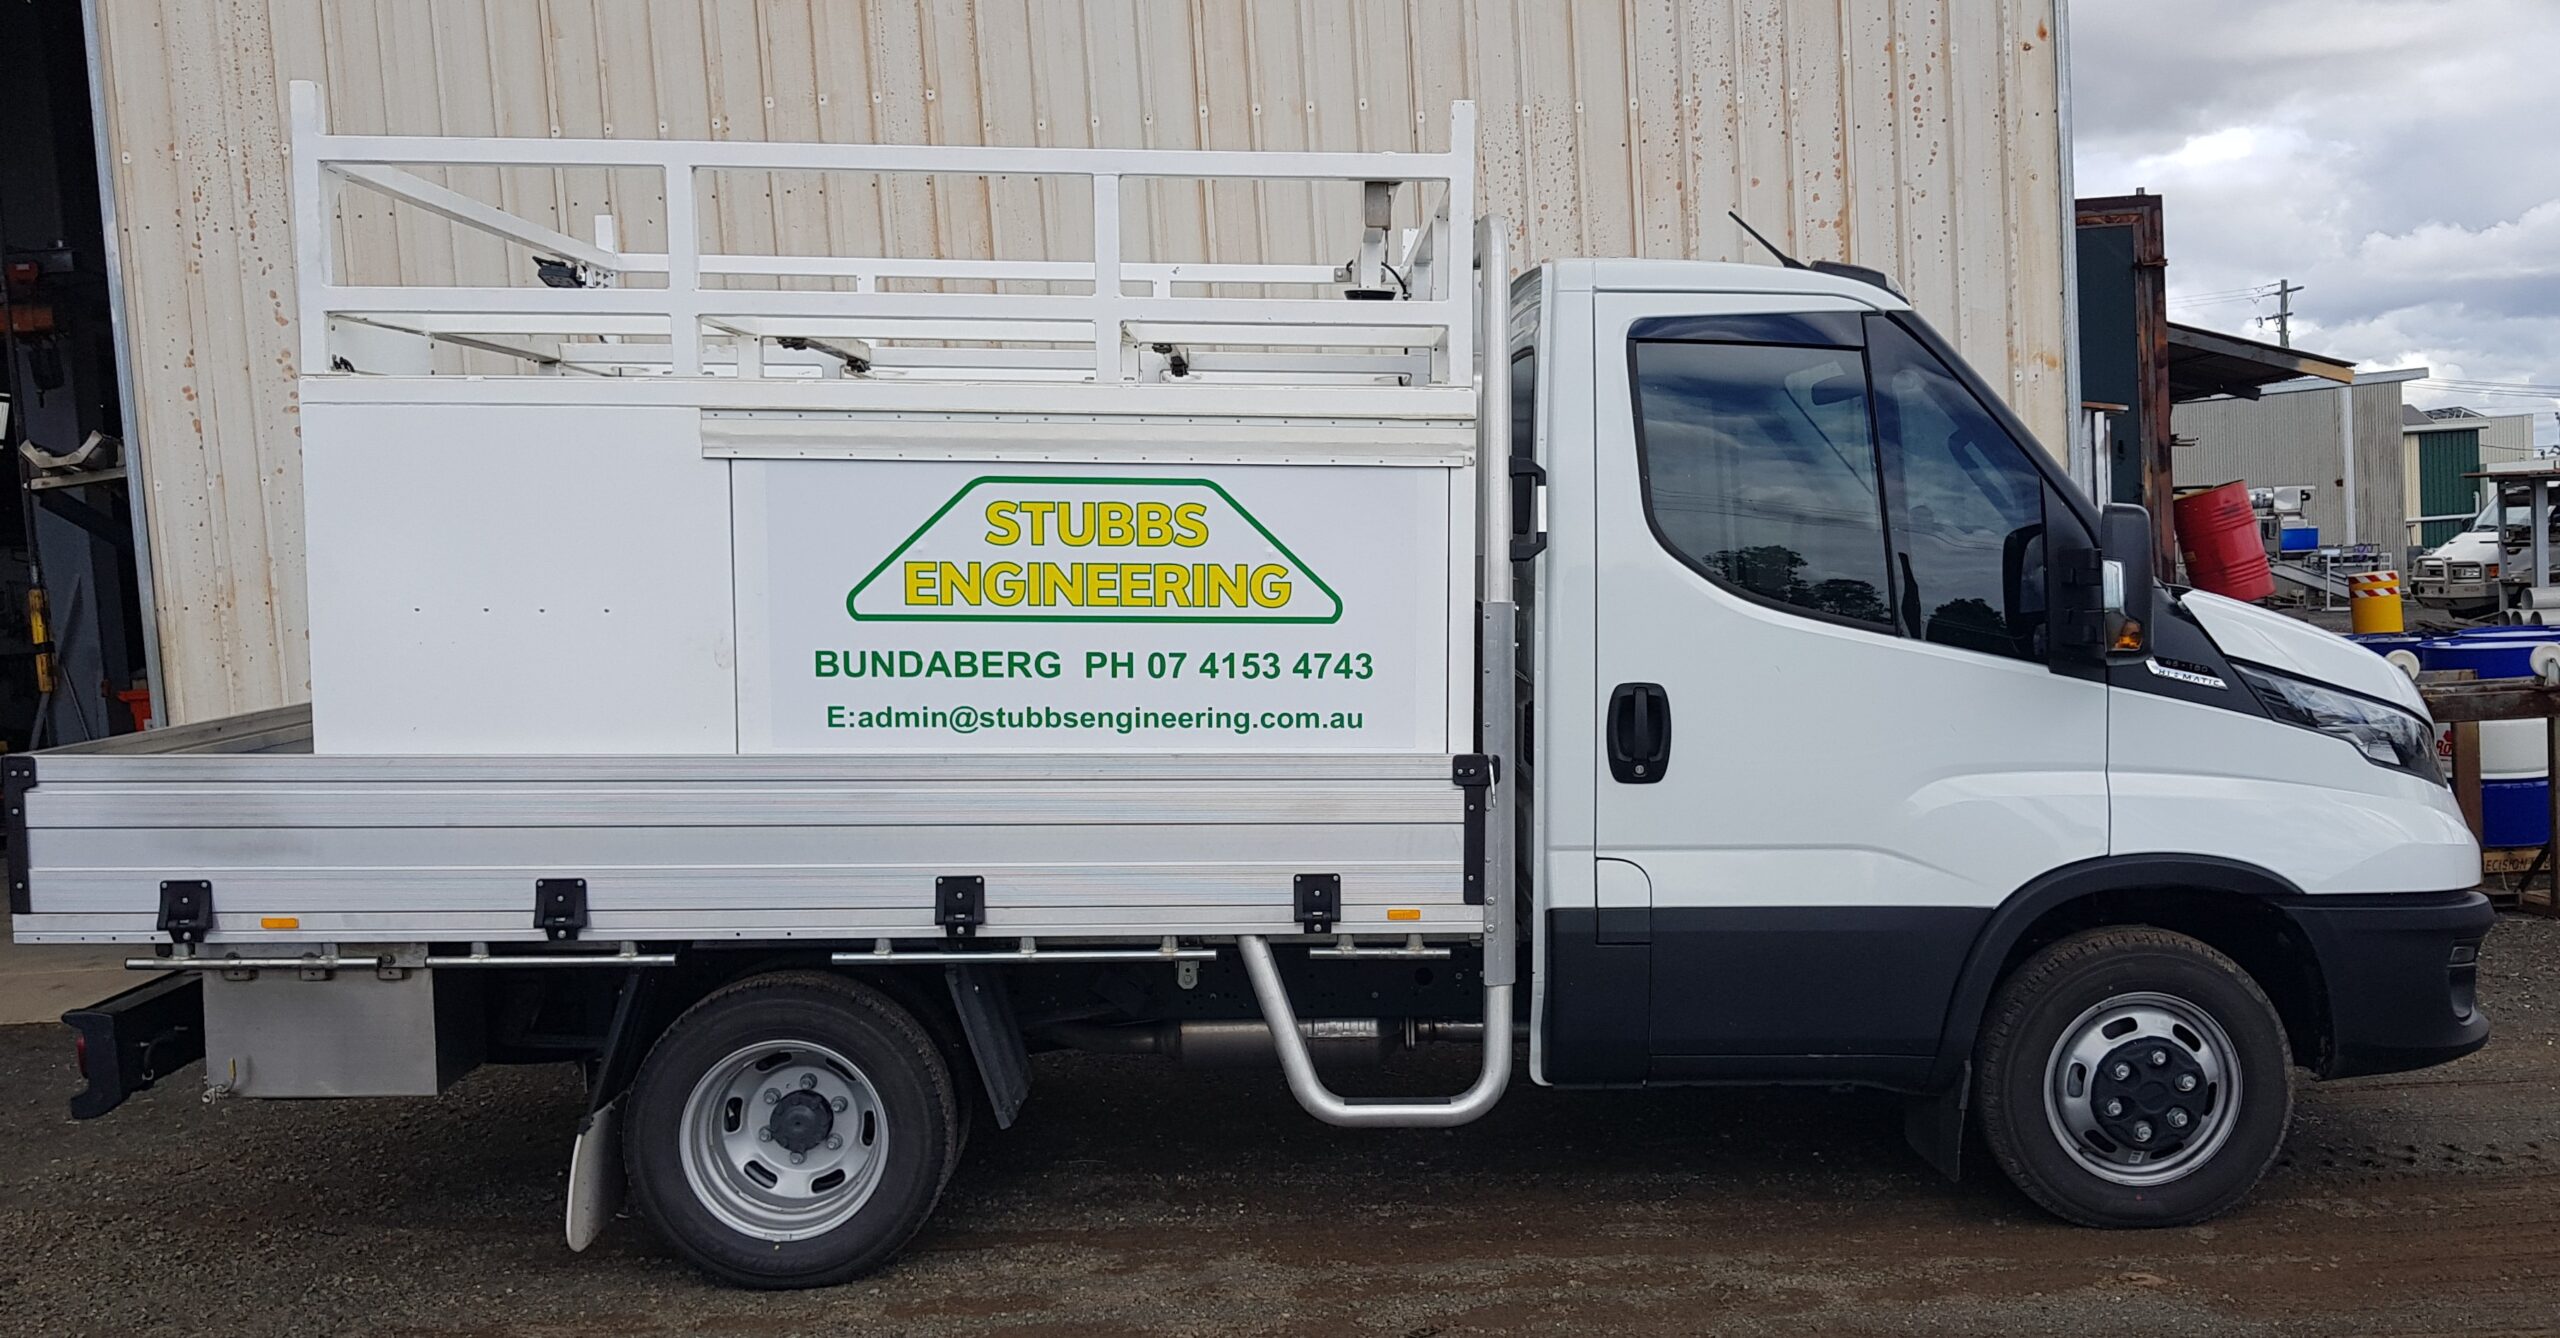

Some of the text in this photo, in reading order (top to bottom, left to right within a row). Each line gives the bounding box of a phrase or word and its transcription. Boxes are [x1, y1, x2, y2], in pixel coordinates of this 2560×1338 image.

[985, 501, 1209, 547] STUBBS
[904, 561, 1292, 608] ENGINEERING
[815, 650, 1374, 680] BUNDABERG PH 07 4153 4743
[827, 705, 1364, 735] E:admin@stubbsengineering.com.au
